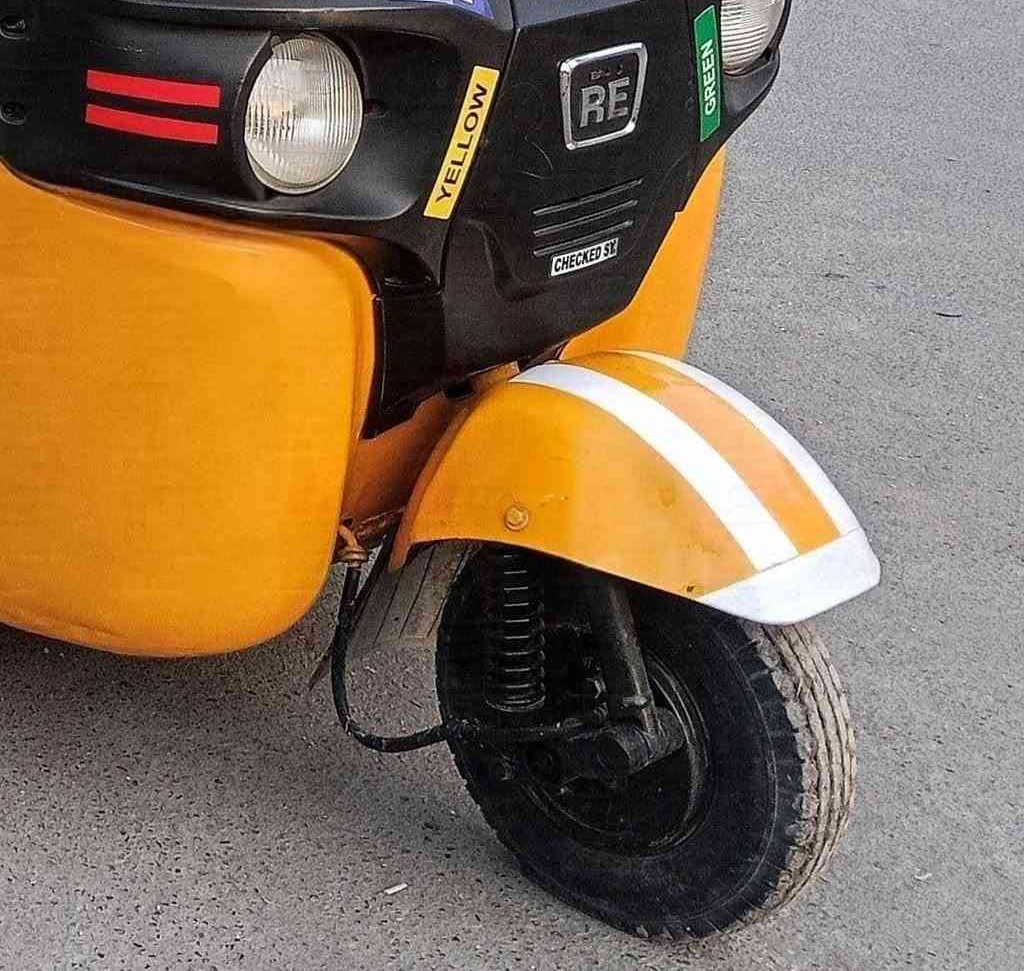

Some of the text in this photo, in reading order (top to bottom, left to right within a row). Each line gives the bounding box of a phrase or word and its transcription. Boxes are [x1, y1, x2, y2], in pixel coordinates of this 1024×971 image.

[579, 76, 631, 129] RE
[702, 37, 715, 116] GREEN
[435, 82, 489, 203] YELLOW
[554, 245, 602, 273] CHECKED
